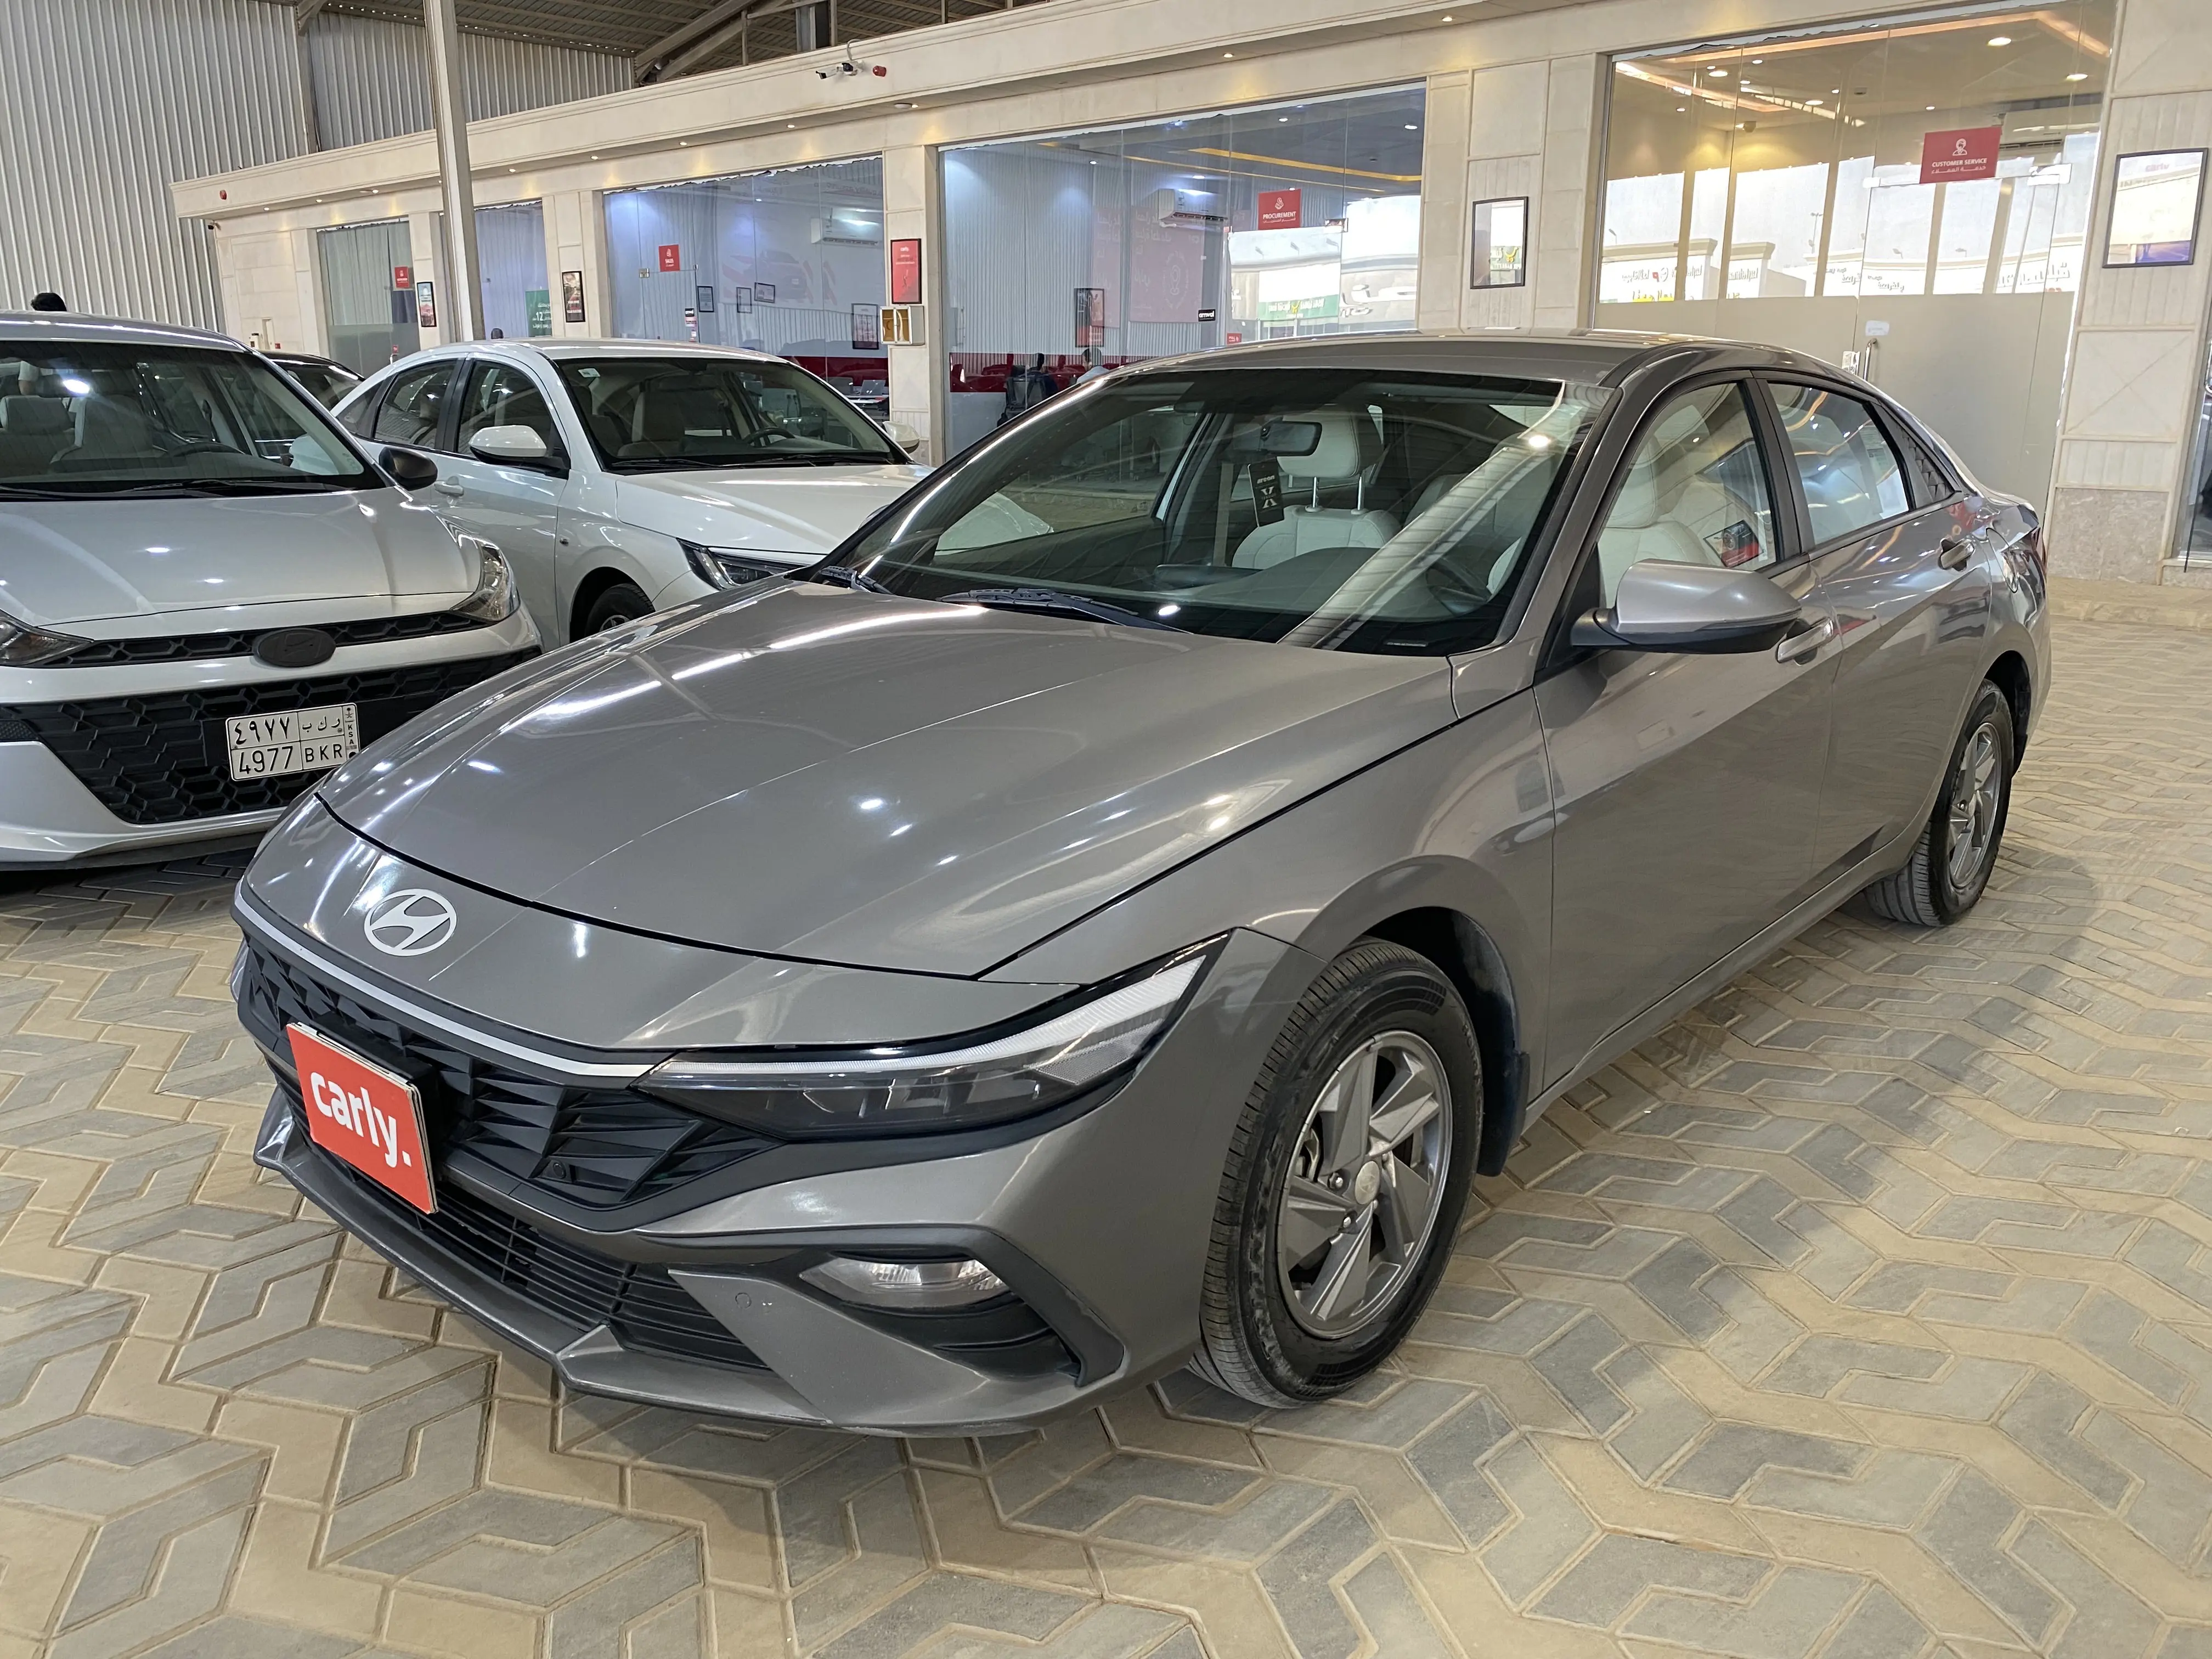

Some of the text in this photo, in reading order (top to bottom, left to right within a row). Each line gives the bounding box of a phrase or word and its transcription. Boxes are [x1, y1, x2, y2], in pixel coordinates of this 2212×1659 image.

[1262, 211, 1296, 219] PROCUREMENT
[1257, 475, 1275, 484] areon
[234, 716, 290, 744] ٤٩٧٧
[239, 746, 293, 774] 4977
[311, 1071, 412, 1168] carly.
